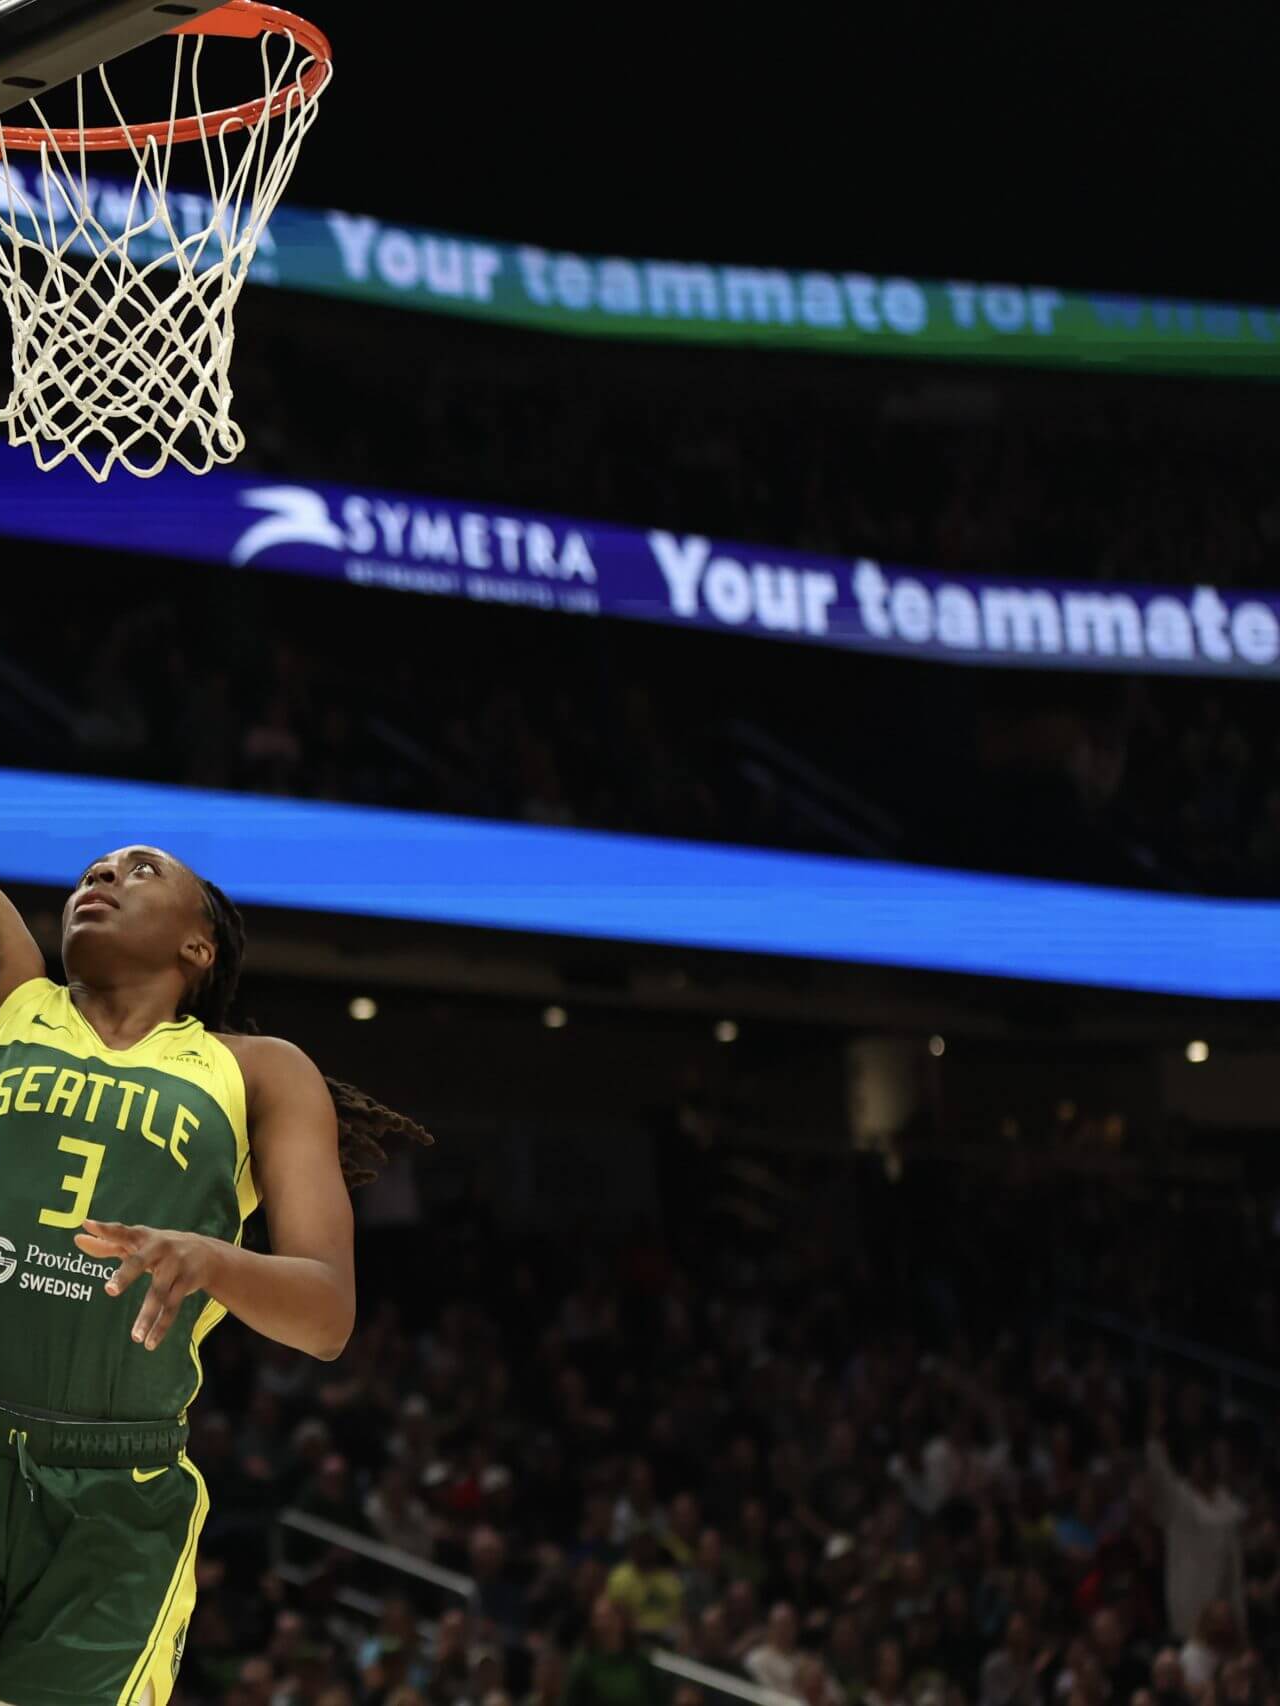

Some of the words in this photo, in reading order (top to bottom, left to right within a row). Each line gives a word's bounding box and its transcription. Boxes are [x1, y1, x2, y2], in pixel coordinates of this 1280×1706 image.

[324, 208, 502, 304] Your
[518, 242, 927, 335] teammate
[342, 495, 598, 584] SYMETRA
[647, 528, 837, 637] Your
[852, 558, 1280, 666] teammate
[38, 1136, 106, 1229] 3
[19, 1272, 93, 1302] SWEDISH
